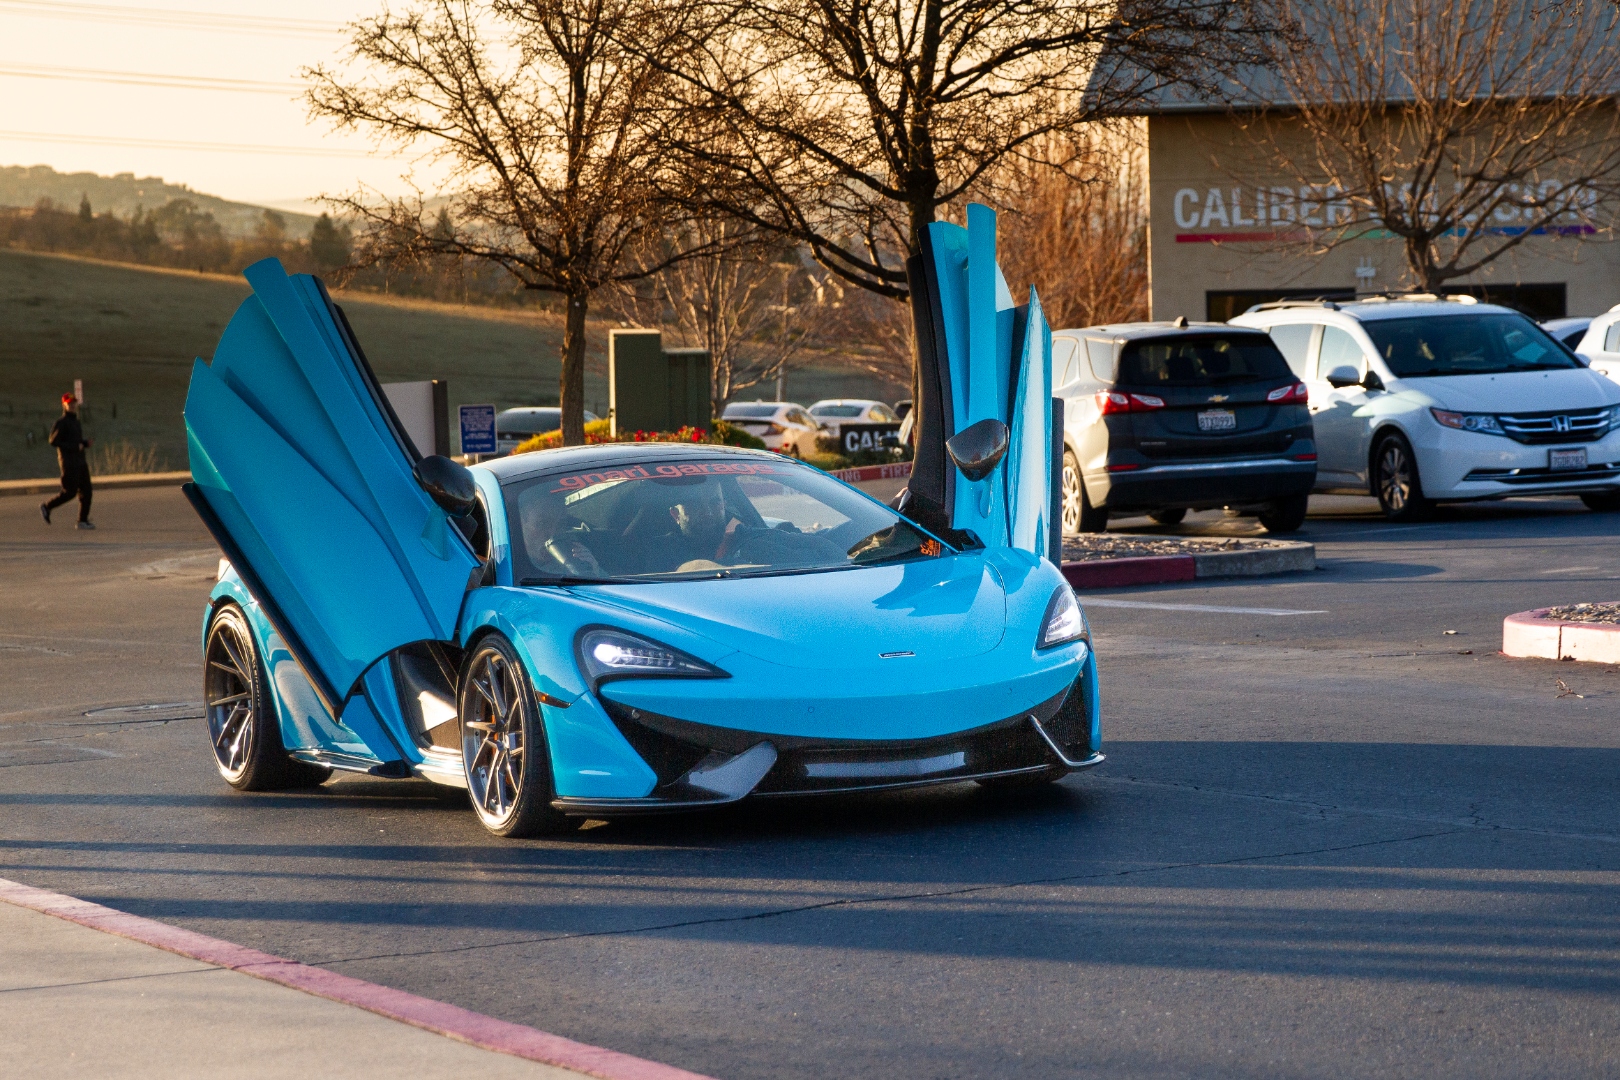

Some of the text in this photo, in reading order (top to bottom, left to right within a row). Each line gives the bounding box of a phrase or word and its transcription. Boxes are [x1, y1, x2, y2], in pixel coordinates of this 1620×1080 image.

[1173, 185, 1352, 229] CALIBER
[559, 462, 775, 490] gnari garage
[881, 463, 910, 478] FIRE
